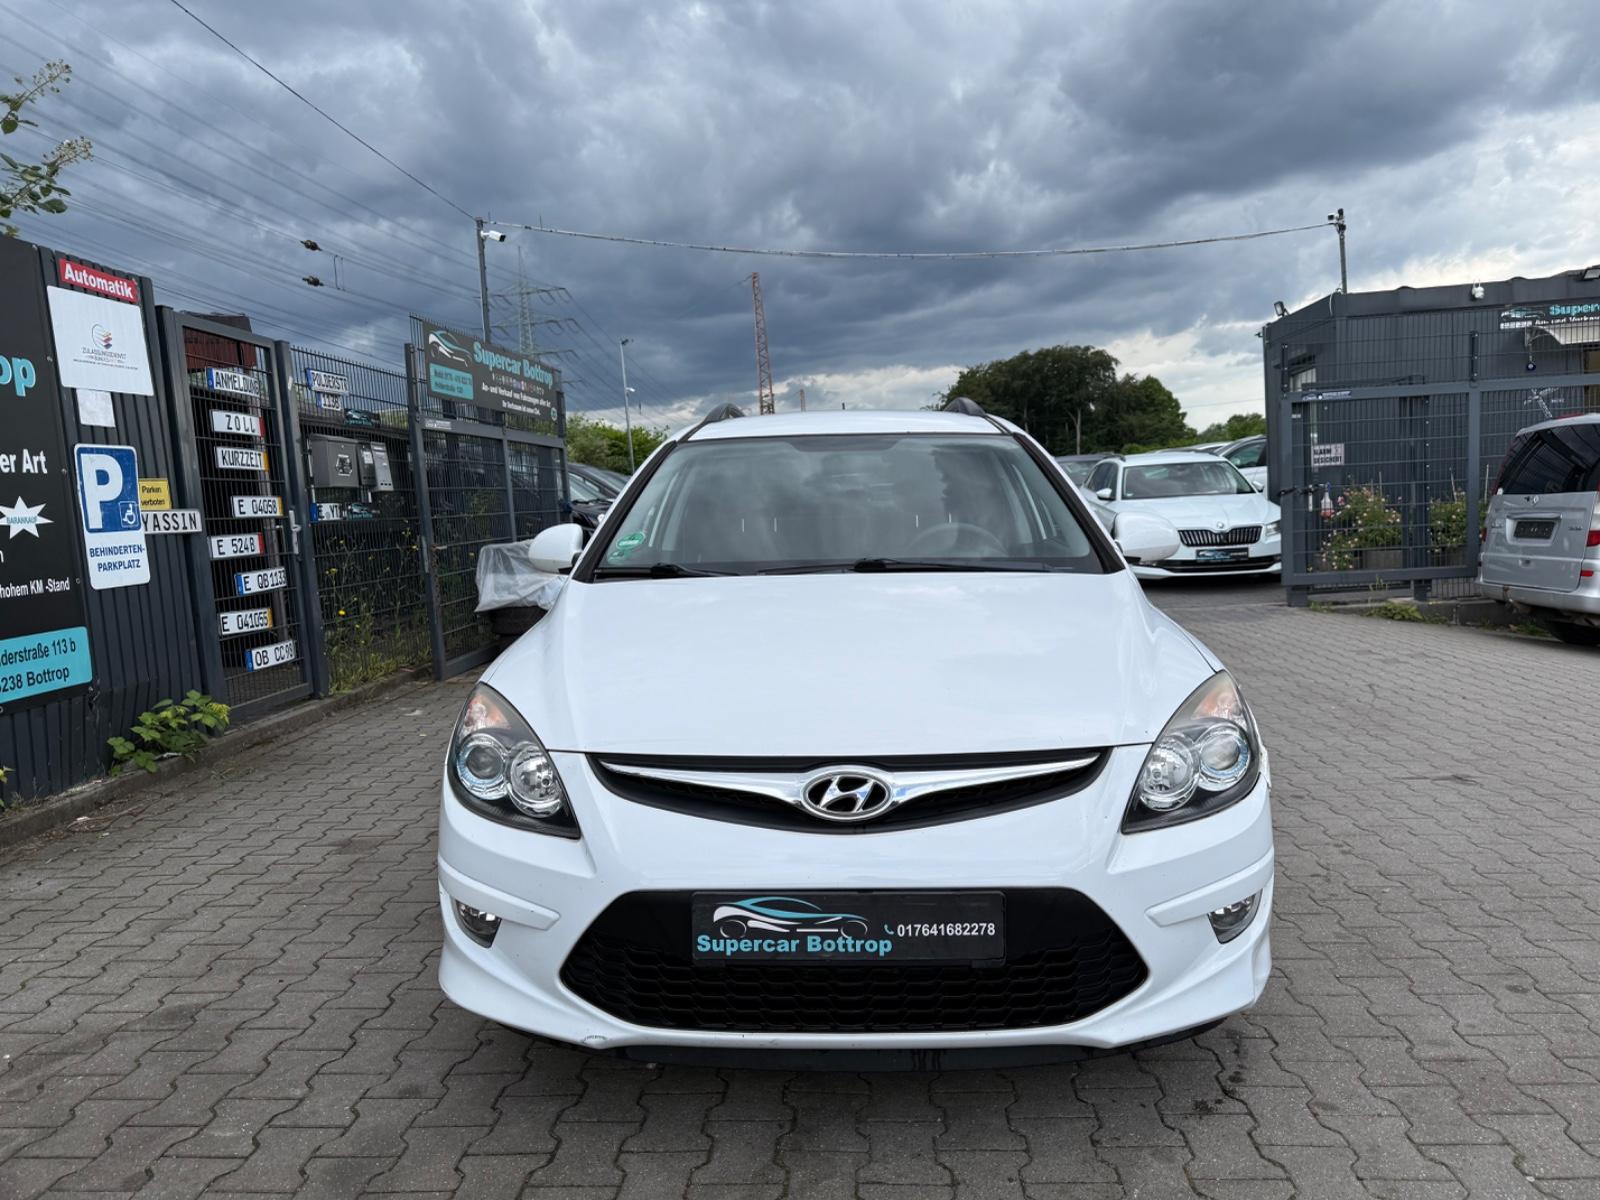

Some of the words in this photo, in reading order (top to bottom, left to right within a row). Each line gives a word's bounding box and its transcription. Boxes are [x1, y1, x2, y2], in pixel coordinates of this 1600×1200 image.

[64, 263, 134, 299] Automatik
[473, 341, 521, 375] Supercar
[523, 359, 553, 389] Bottrop
[225, 414, 256, 433] ZOLL
[0, 453, 16, 473] er
[22, 448, 48, 474] Art
[221, 449, 262, 468] KURZZEIT
[80, 453, 123, 529] P
[141, 485, 162, 494] Parken
[238, 499, 246, 515] E
[141, 512, 197, 532] YASSIN
[89, 544, 145, 558] BEHINDERTEN-
[217, 539, 226, 555] E
[97, 558, 141, 572] PARKPLATZ
[0, 582, 29, 599] hohem
[243, 575, 252, 591] E
[221, 615, 230, 632] E
[52, 638, 68, 656] 113
[69, 637, 76, 653] b
[254, 649, 270, 667] OB
[26, 667, 70, 688] Bottrop
[897, 922, 996, 937] 017641682278
[696, 934, 800, 956] Supercar
[806, 934, 893, 956] Bottrop
